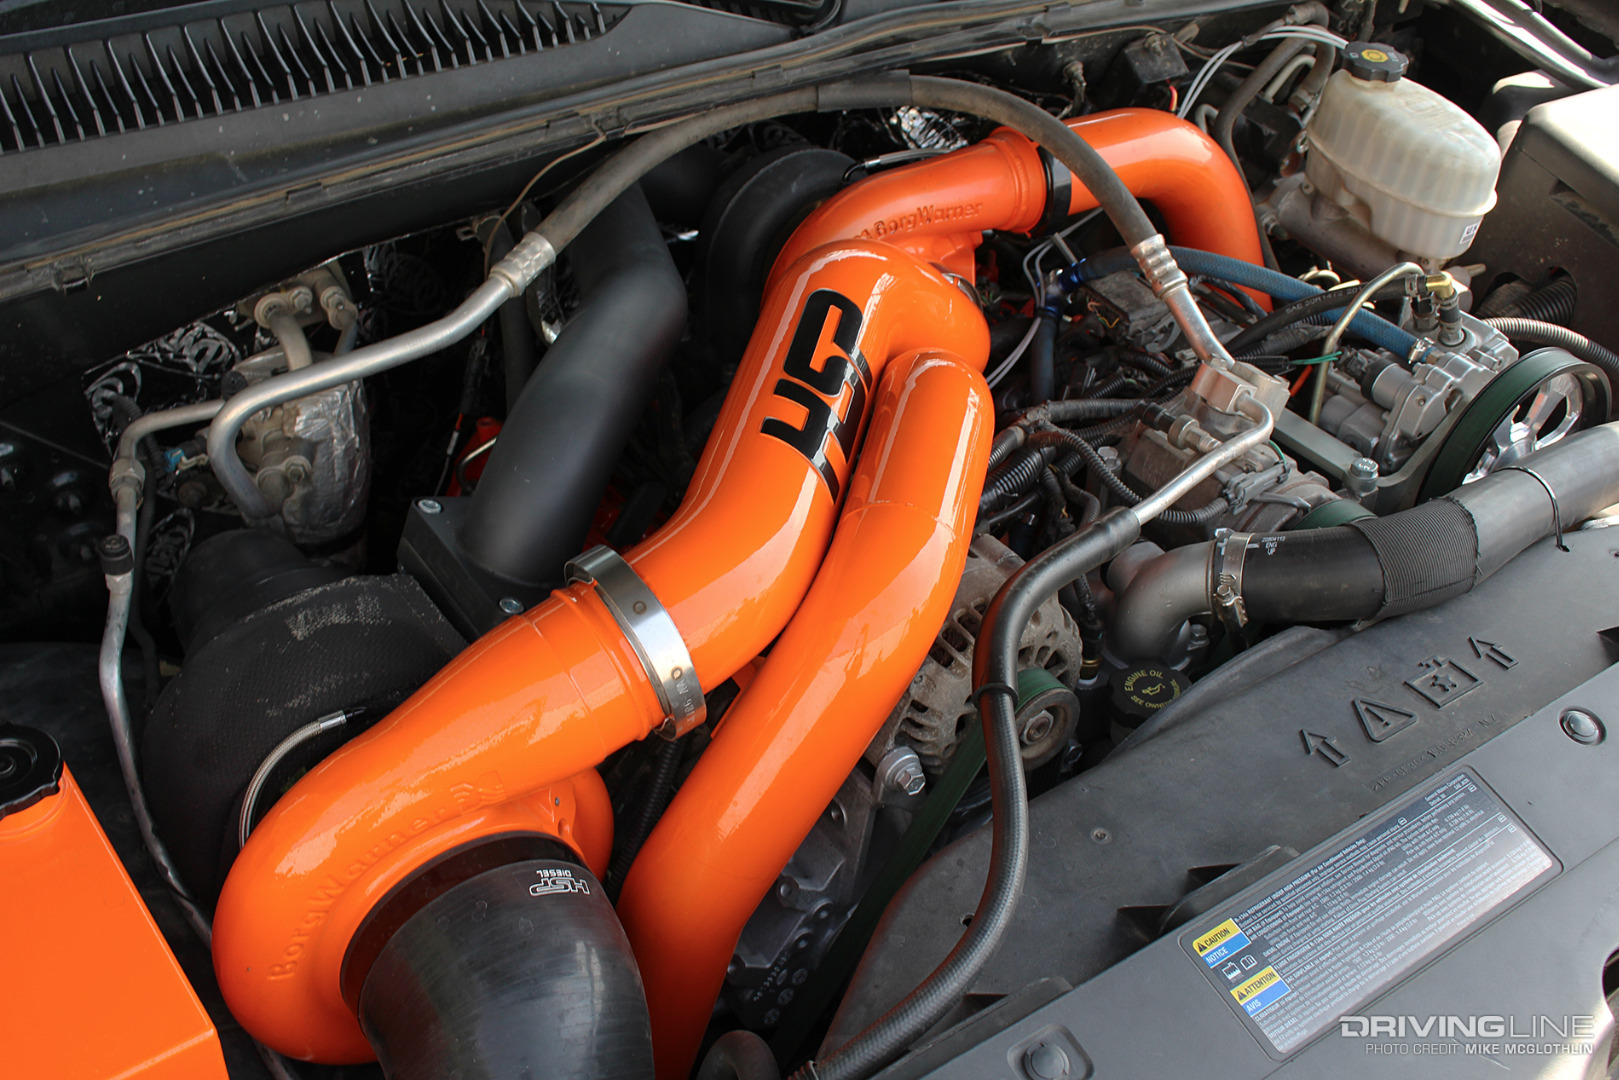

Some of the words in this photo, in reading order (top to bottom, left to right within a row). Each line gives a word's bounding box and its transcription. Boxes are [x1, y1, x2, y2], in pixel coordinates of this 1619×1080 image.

[873, 203, 983, 240] BorgWarner
[1124, 669, 1148, 692] ENGINE
[1149, 669, 1164, 679] OIL
[1130, 695, 1145, 705] SEE
[535, 868, 572, 878] DIESEL
[266, 807, 447, 981] BorgWarner
[528, 877, 591, 897] HSP
[1204, 928, 1230, 947] CAUTION
[1205, 946, 1229, 965] NOTICE
[1244, 970, 1276, 995] ATTENTION
[1245, 999, 1262, 1013] AVIS
